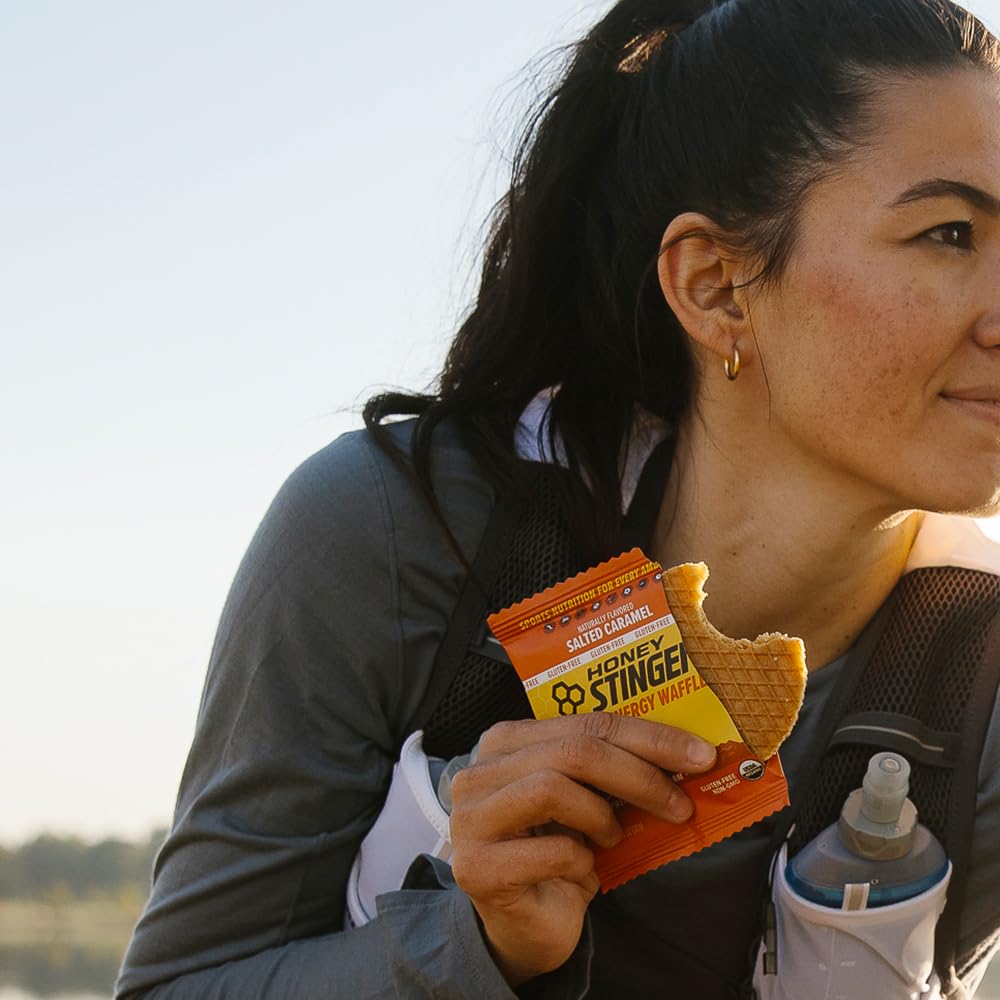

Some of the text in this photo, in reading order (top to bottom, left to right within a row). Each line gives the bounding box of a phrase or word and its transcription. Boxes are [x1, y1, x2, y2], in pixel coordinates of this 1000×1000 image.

[519, 610, 550, 631] SPORTS
[551, 588, 596, 616] NUTRITION
[597, 580, 614, 596] FOR
[615, 568, 639, 587] EVERY
[577, 602, 635, 633] NATURALLY FLAVORED
[547, 657, 582, 679] GLUTEN-FREE
[590, 637, 625, 659] GLUTEN-FREE
[634, 617, 670, 638] GLUTEN-FREE
[566, 605, 654, 653] SALTED CARAMEL
[587, 634, 664, 681] HONEY
[613, 693, 655, 718] NERGY
[700, 772, 737, 792] GLUTEN-FREE
[712, 779, 741, 795] NON-GMO
